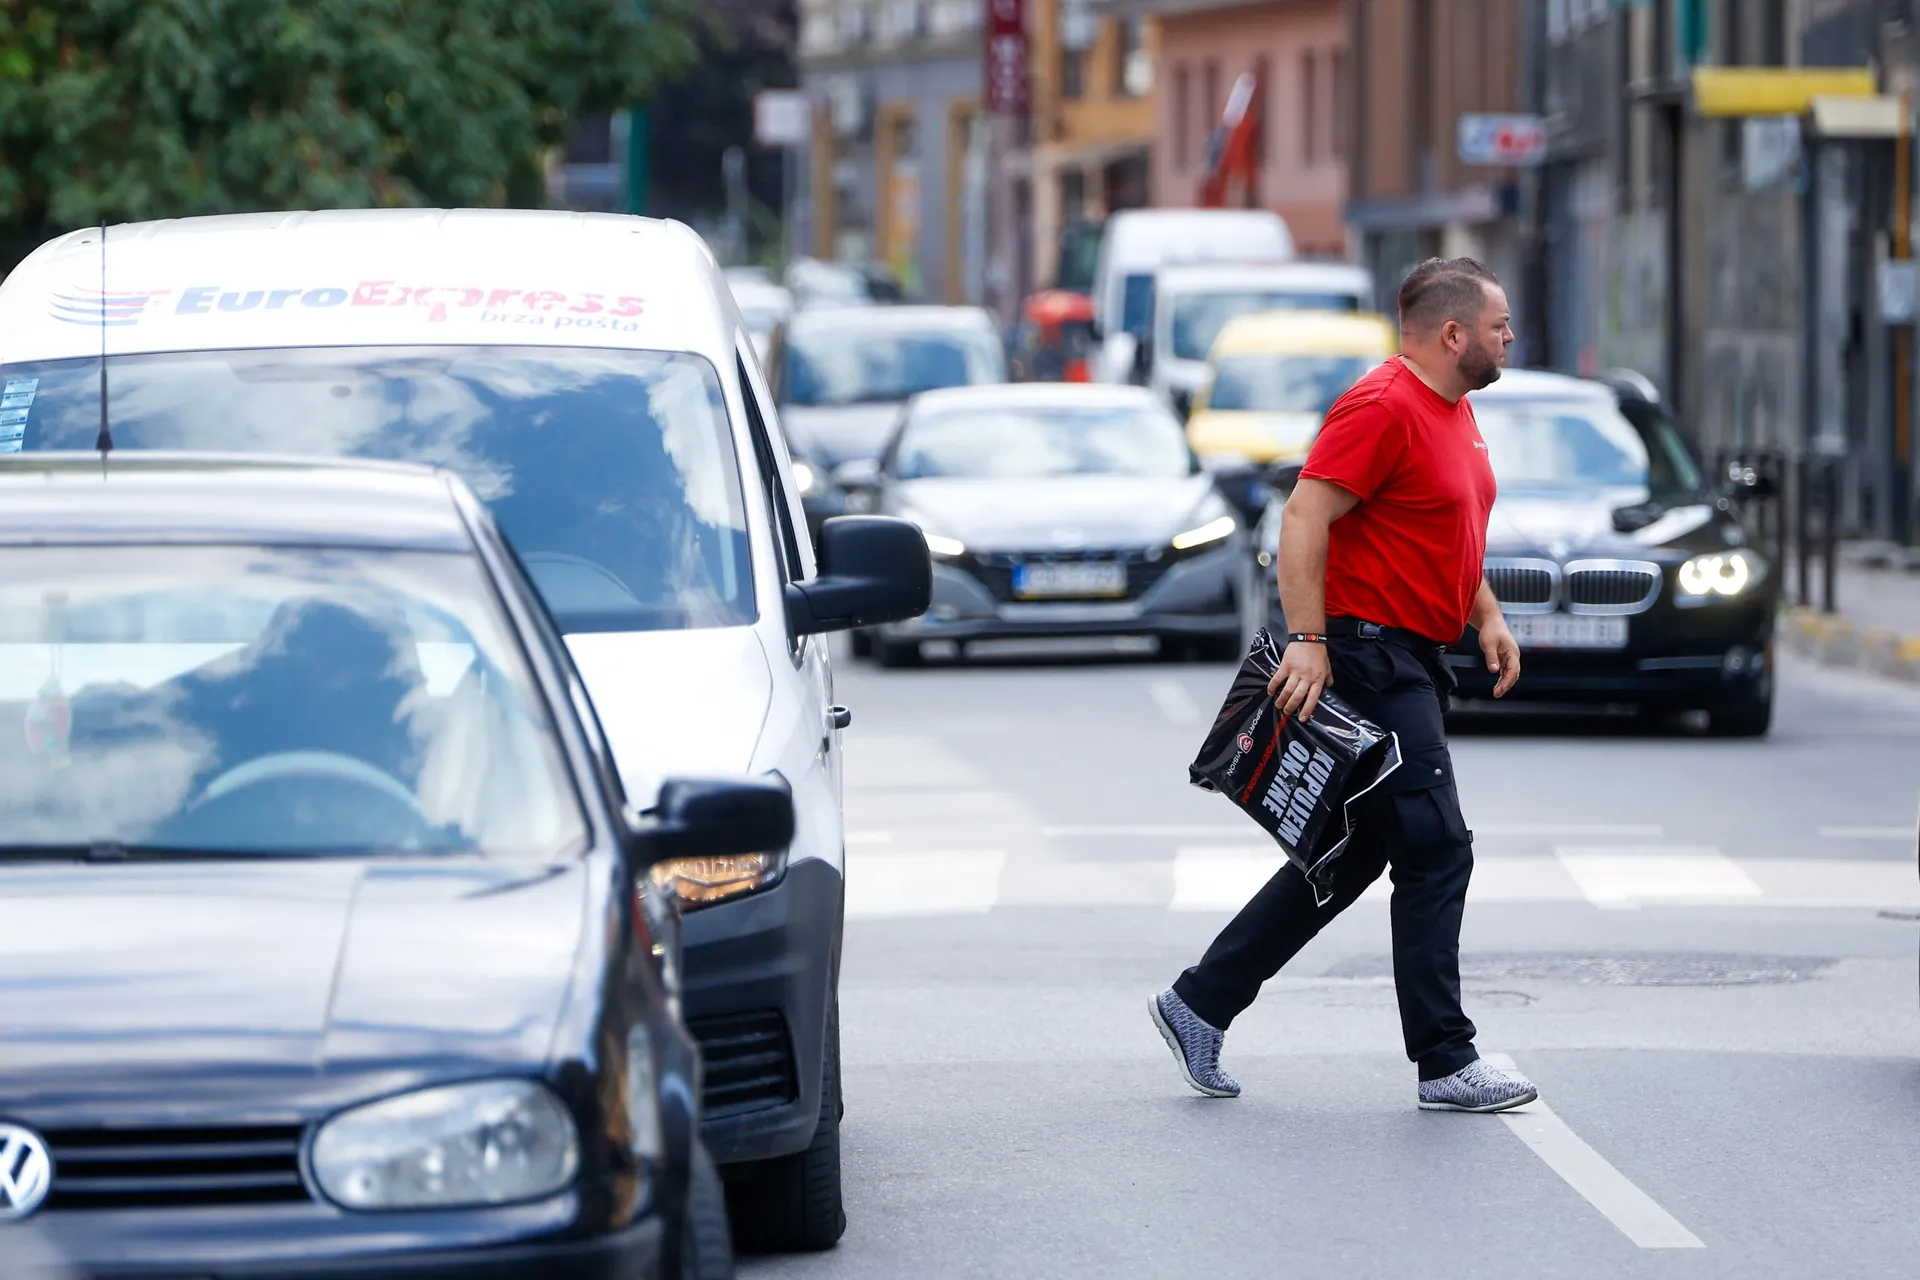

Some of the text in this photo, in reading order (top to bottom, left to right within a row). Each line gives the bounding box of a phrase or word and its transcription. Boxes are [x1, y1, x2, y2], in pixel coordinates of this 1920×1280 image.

[480, 309, 639, 331] brza pošta
[1226, 708, 1264, 777] SPORT VISION
[1277, 746, 1336, 847] KUPUJEM
